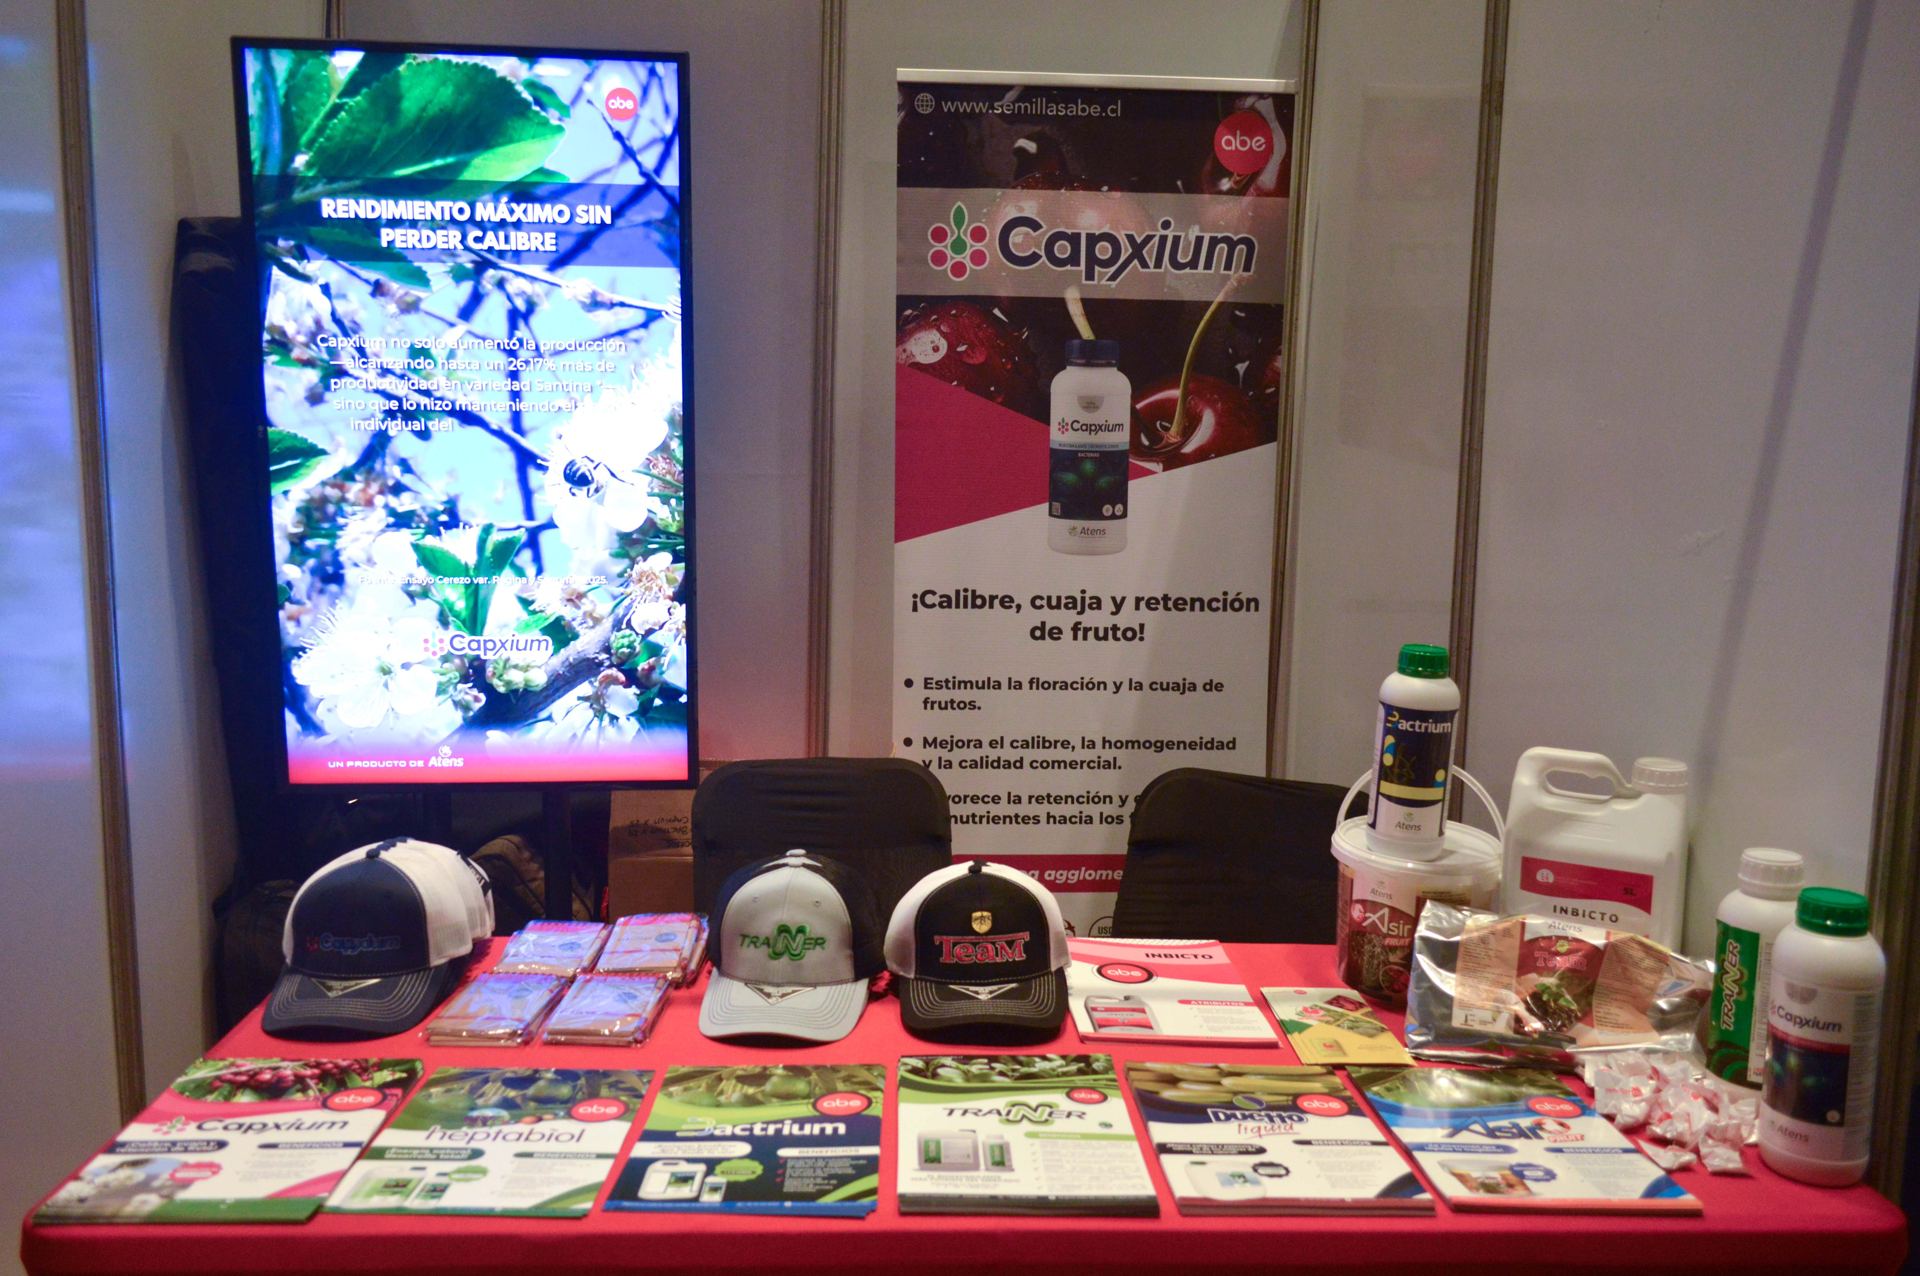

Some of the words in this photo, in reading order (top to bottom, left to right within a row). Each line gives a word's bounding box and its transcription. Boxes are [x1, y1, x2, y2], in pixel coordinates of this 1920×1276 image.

[608, 97, 634, 110] abe
[942, 98, 1122, 118] www.semillasabe.cl
[1221, 130, 1266, 152] abe
[321, 198, 470, 221] RENDIMIENTO
[475, 197, 570, 224] MÁXIMO
[575, 205, 612, 225] SIN
[380, 229, 463, 250] PERDER
[467, 230, 556, 252] CALIBRE
[999, 215, 1257, 283] Capxium
[317, 335, 386, 350] Capxium
[391, 338, 410, 348] no
[414, 337, 445, 349] solo
[451, 337, 519, 350] aumentó
[523, 338, 535, 350] la
[540, 338, 625, 353] producción
[438, 358, 479, 370] hasta
[485, 361, 503, 371] un
[561, 359, 592, 371] más
[597, 360, 615, 372] de
[330, 377, 438, 391] productividad
[443, 380, 461, 390] en
[466, 378, 530, 391] variedad
[334, 398, 365, 410] sino
[369, 399, 399, 413] que
[403, 397, 416, 410] lo
[421, 398, 452, 411] hizo
[456, 399, 560, 411] manteniendo
[351, 418, 425, 431] individual
[429, 419, 452, 431] del
[1070, 419, 1124, 436] Capxium
[1079, 527, 1106, 536] Atens
[436, 576, 471, 584] Cerezo
[911, 589, 1022, 614] ¡Calibre,
[1030, 591, 1102, 615] cuaja
[1110, 597, 1126, 616] y
[1134, 592, 1259, 613] retención
[1030, 621, 1063, 641] de
[1071, 621, 1145, 641] fruto!
[450, 634, 549, 656] Capxium
[923, 676, 1001, 691] Estimula
[1007, 677, 1022, 691] la
[1028, 676, 1107, 691] floración
[1113, 681, 1124, 694] y
[1128, 678, 1143, 691] la
[1149, 679, 1197, 695] cuaja
[1203, 679, 1224, 692] de
[923, 697, 982, 711] frutos.
[922, 736, 983, 752] Mejora
[988, 736, 1004, 750] el
[1010, 736, 1075, 752] calibre,
[1081, 737, 1096, 750] la
[1101, 737, 1236, 753] homogeneidad
[346, 760, 407, 768] PRODUCTO
[428, 756, 464, 767] Atens
[938, 756, 953, 770] la
[958, 756, 1024, 770] calidad
[1029, 756, 1122, 770] comercial.
[947, 793, 1001, 804] vorece
[1007, 792, 1022, 804] la
[1028, 791, 1113, 804] retención
[1118, 794, 1129, 807] y
[950, 811, 1041, 825] nutrientes
[1047, 812, 1093, 825] hacia
[1100, 812, 1124, 825] los
[1395, 822, 1421, 832] Atens
[1044, 867, 1123, 884] agglome
[1362, 907, 1412, 937] Asir
[1553, 905, 1620, 923] INBICTO
[1098, 926, 1113, 935] USD
[740, 924, 826, 961] TRAINER
[1145, 952, 1214, 960] INBICTO
[1107, 968, 1142, 978] abe
[1720, 940, 1748, 1031] TRAINER
[1777, 1005, 1842, 1034] Capxium
[334, 1094, 375, 1105] abe
[823, 1099, 861, 1108] abe
[1074, 1091, 1101, 1100] abe
[579, 1105, 618, 1114] abe
[1303, 1099, 1342, 1109] abe
[1536, 1103, 1573, 1111] abe
[944, 1102, 1086, 1125] TRAINER
[196, 1119, 349, 1135] Capxium
[676, 1116, 846, 1137] Bactrium
[425, 1126, 586, 1145] heptabiol
